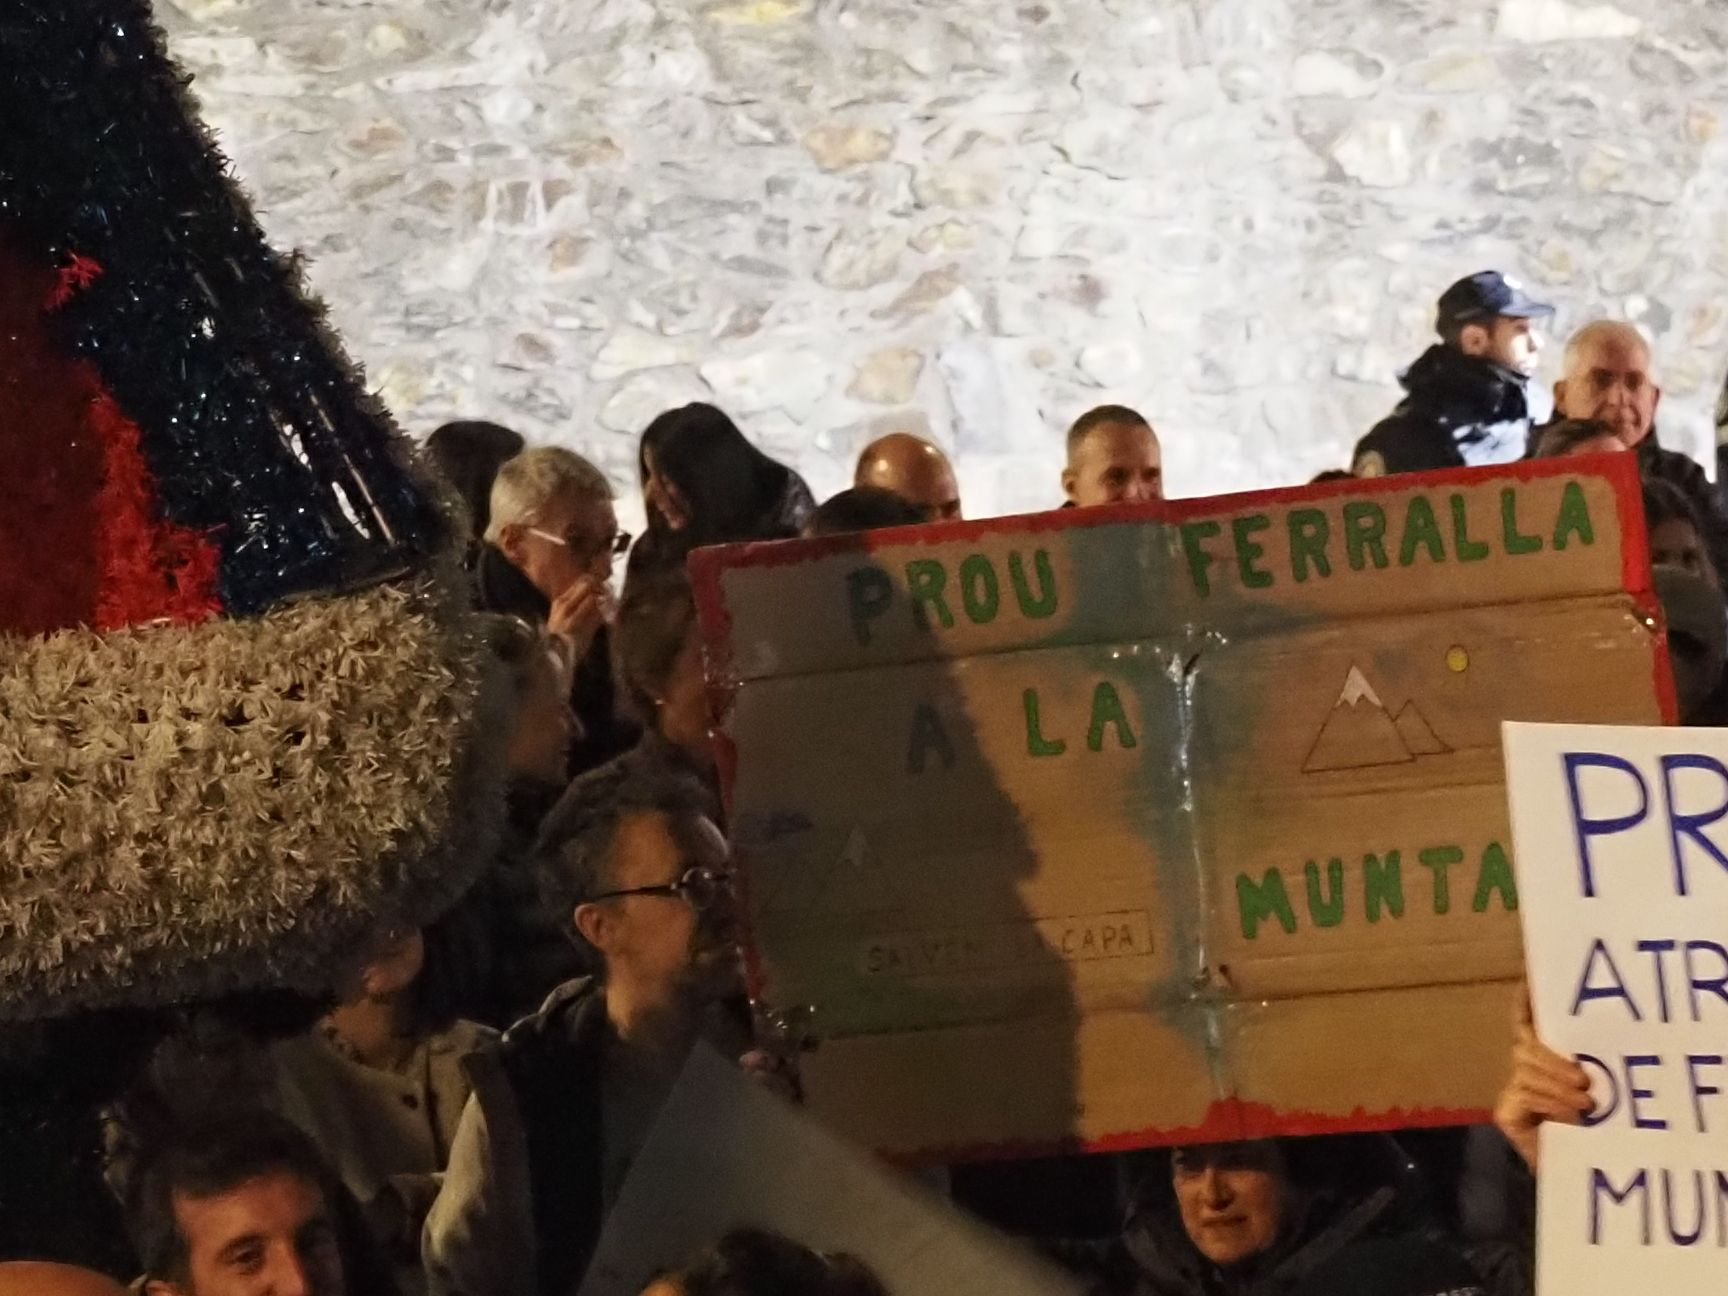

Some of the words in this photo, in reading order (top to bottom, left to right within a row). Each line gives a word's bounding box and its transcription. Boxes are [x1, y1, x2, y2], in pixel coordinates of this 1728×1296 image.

[844, 547, 1060, 647] PROU
[1184, 481, 1596, 598] FERRALLA
[905, 702, 957, 776] A
[1022, 680, 1138, 758] LA
[1060, 923, 1135, 955] CAPA
[1573, 1053, 1668, 1130] DE
